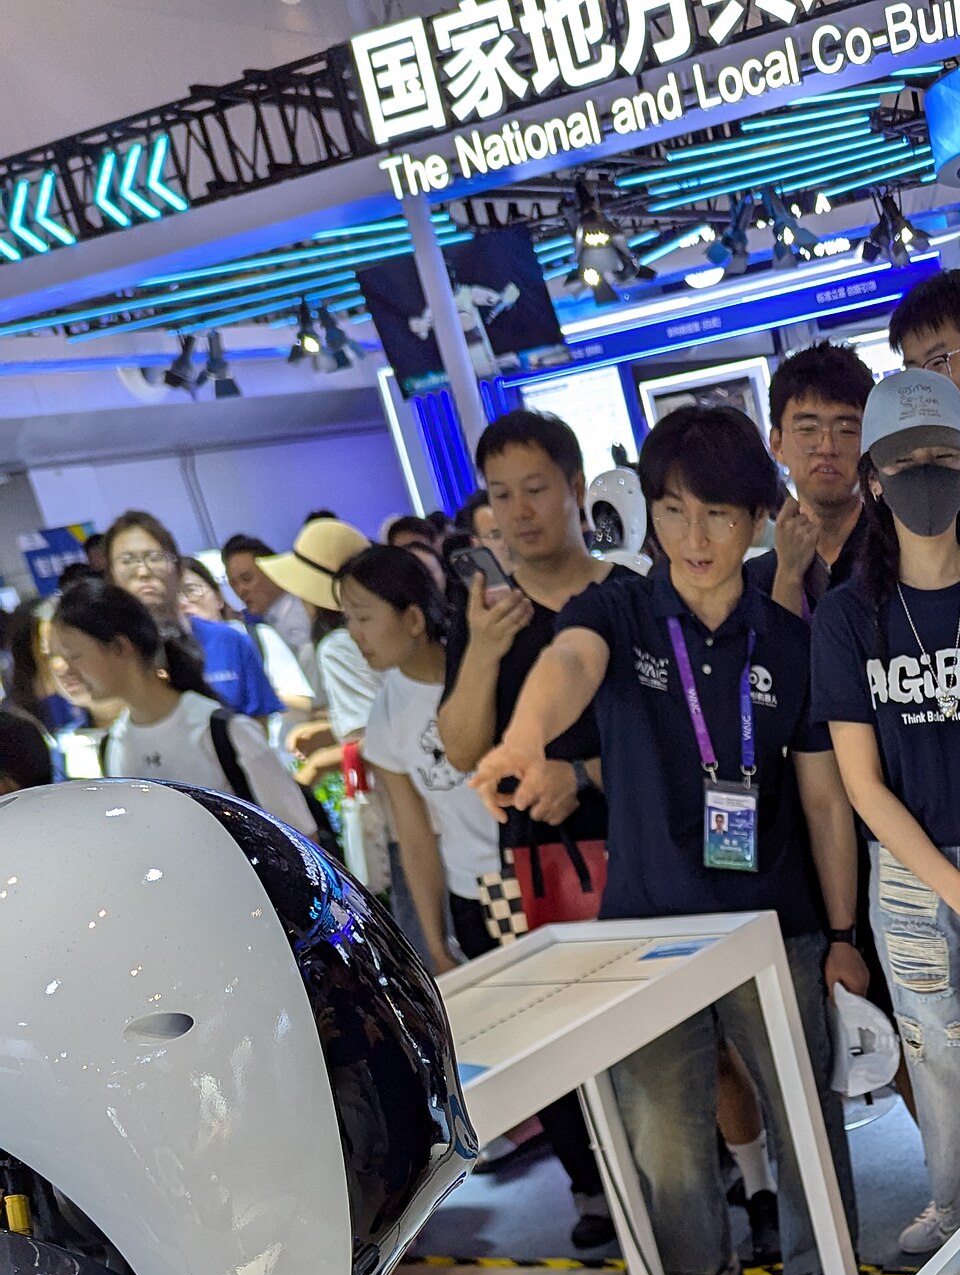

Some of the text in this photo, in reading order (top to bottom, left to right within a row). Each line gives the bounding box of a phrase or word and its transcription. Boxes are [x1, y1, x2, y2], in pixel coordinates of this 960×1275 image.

[351, 0, 796, 145] 国家地方
[379, 151, 450, 200] The
[454, 100, 602, 179] National
[611, 72, 684, 135] and
[692, 37, 802, 109] Local
[741, 714, 752, 741] WAIC
[901, 711, 926, 725] Think
